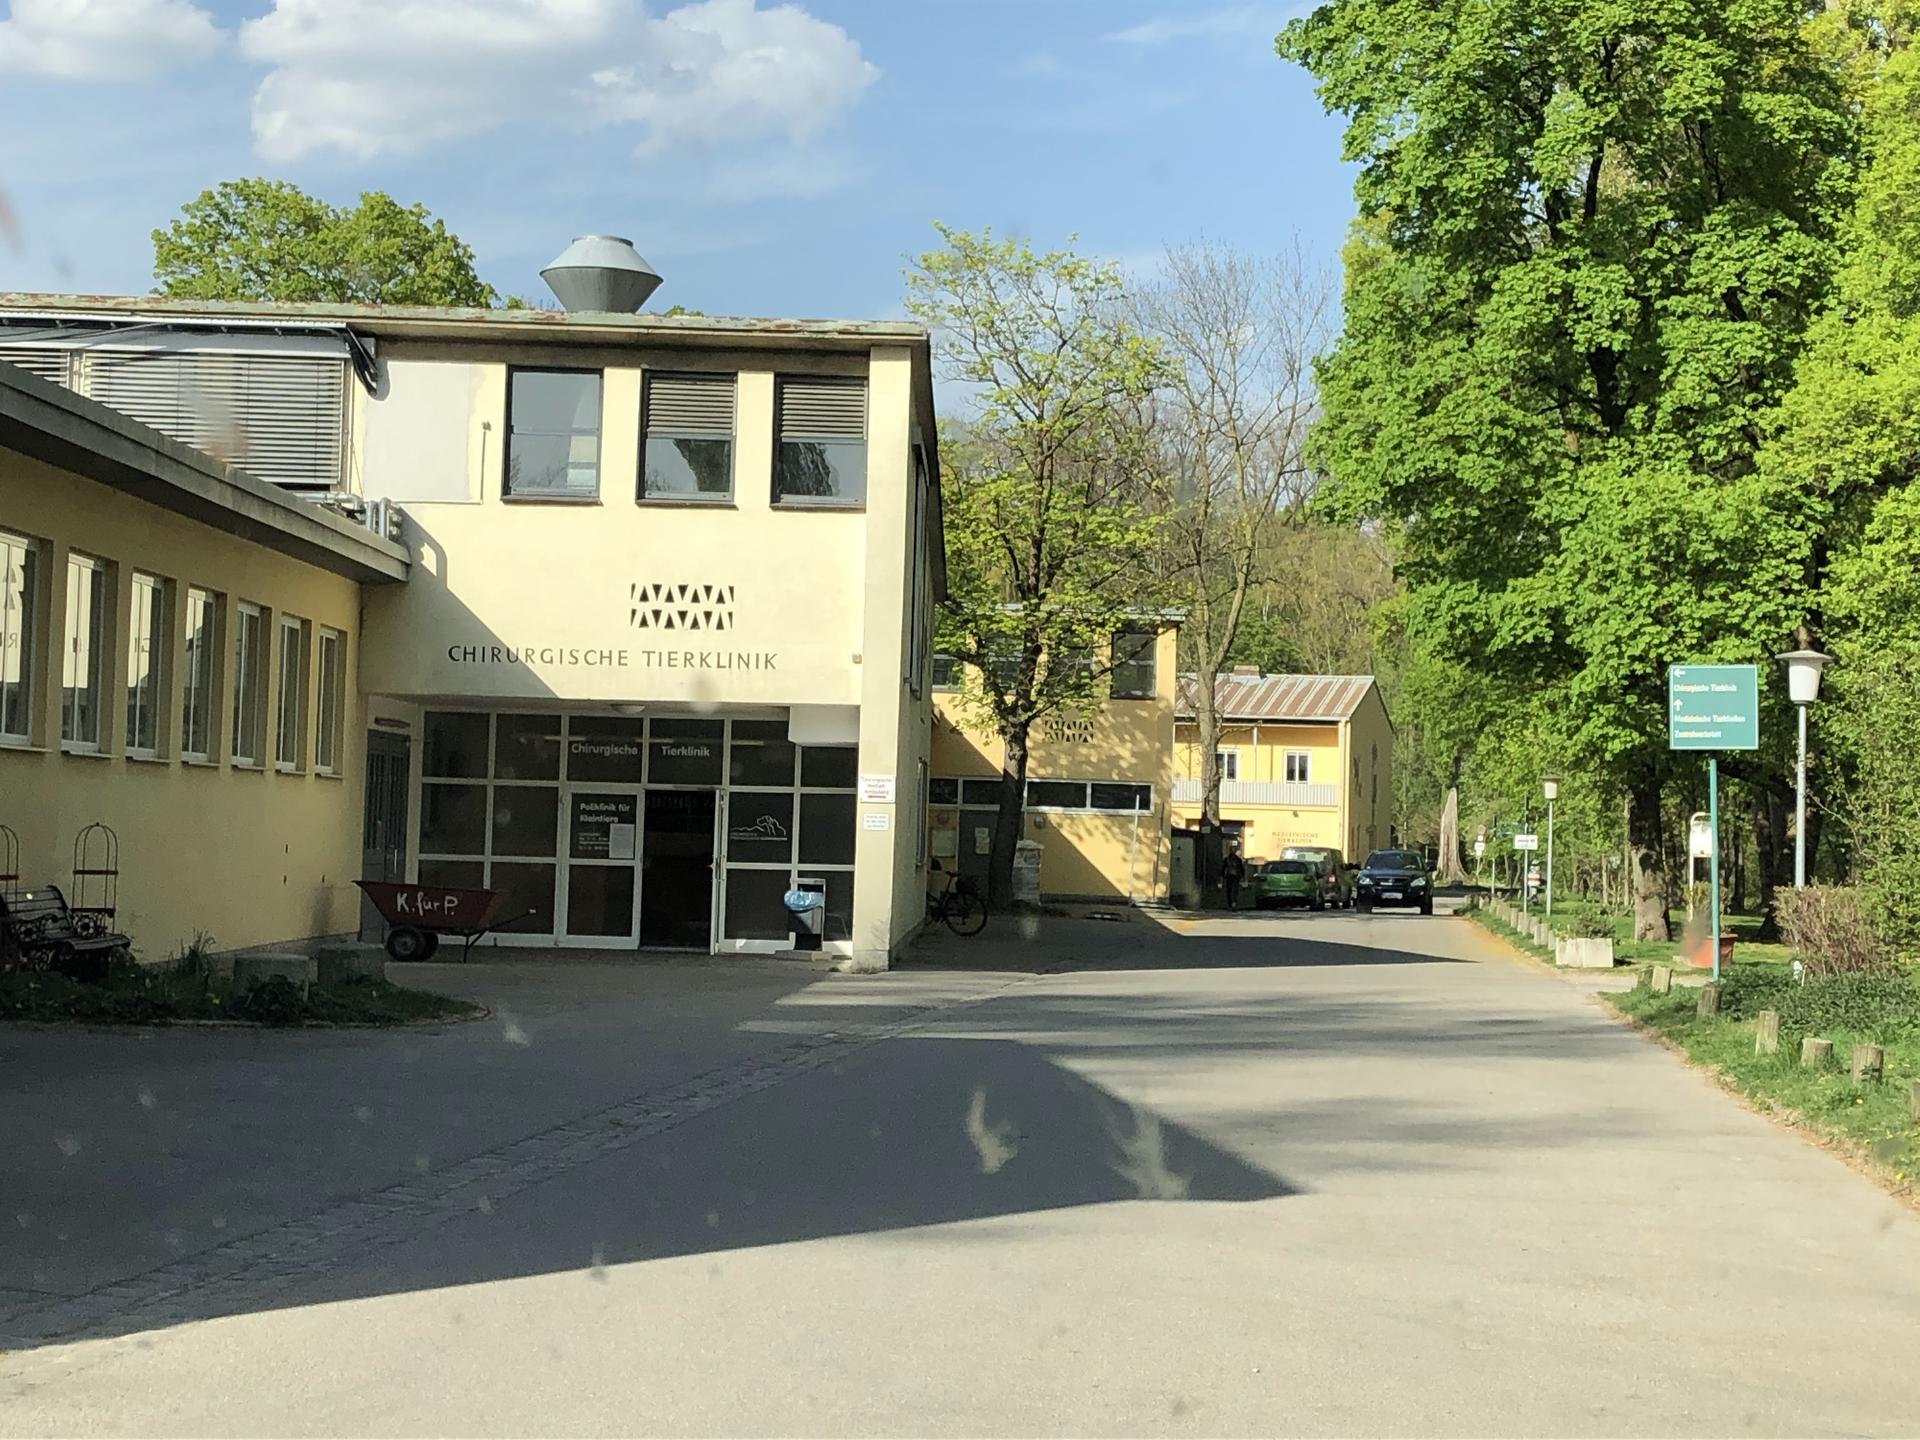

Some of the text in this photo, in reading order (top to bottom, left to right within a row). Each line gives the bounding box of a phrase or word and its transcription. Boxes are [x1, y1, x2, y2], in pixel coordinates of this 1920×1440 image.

[448, 645, 778, 670] CHIRURGISCHE TIERKLINIK
[571, 744, 710, 756] Chirurgische Tierklinik
[396, 893, 414, 912] K.
[444, 896, 458, 915] P.
